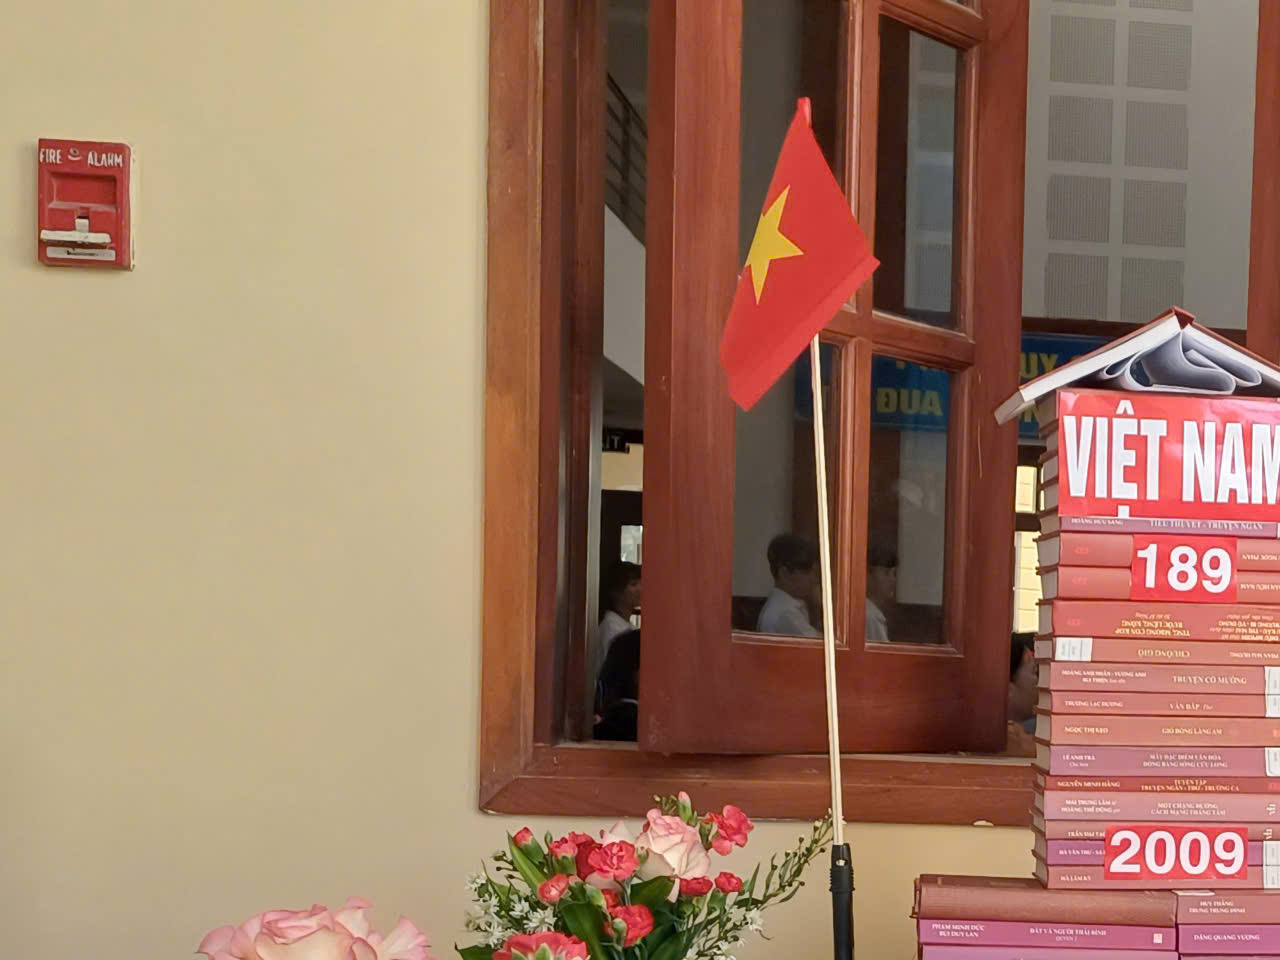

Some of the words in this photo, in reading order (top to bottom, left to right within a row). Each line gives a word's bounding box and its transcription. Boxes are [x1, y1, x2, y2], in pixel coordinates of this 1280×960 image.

[39, 148, 62, 164] FIRE
[87, 151, 123, 168] ALARM
[1062, 400, 1168, 519] VIỆT
[1137, 543, 1233, 593] 189
[1108, 830, 1245, 875] 2009
